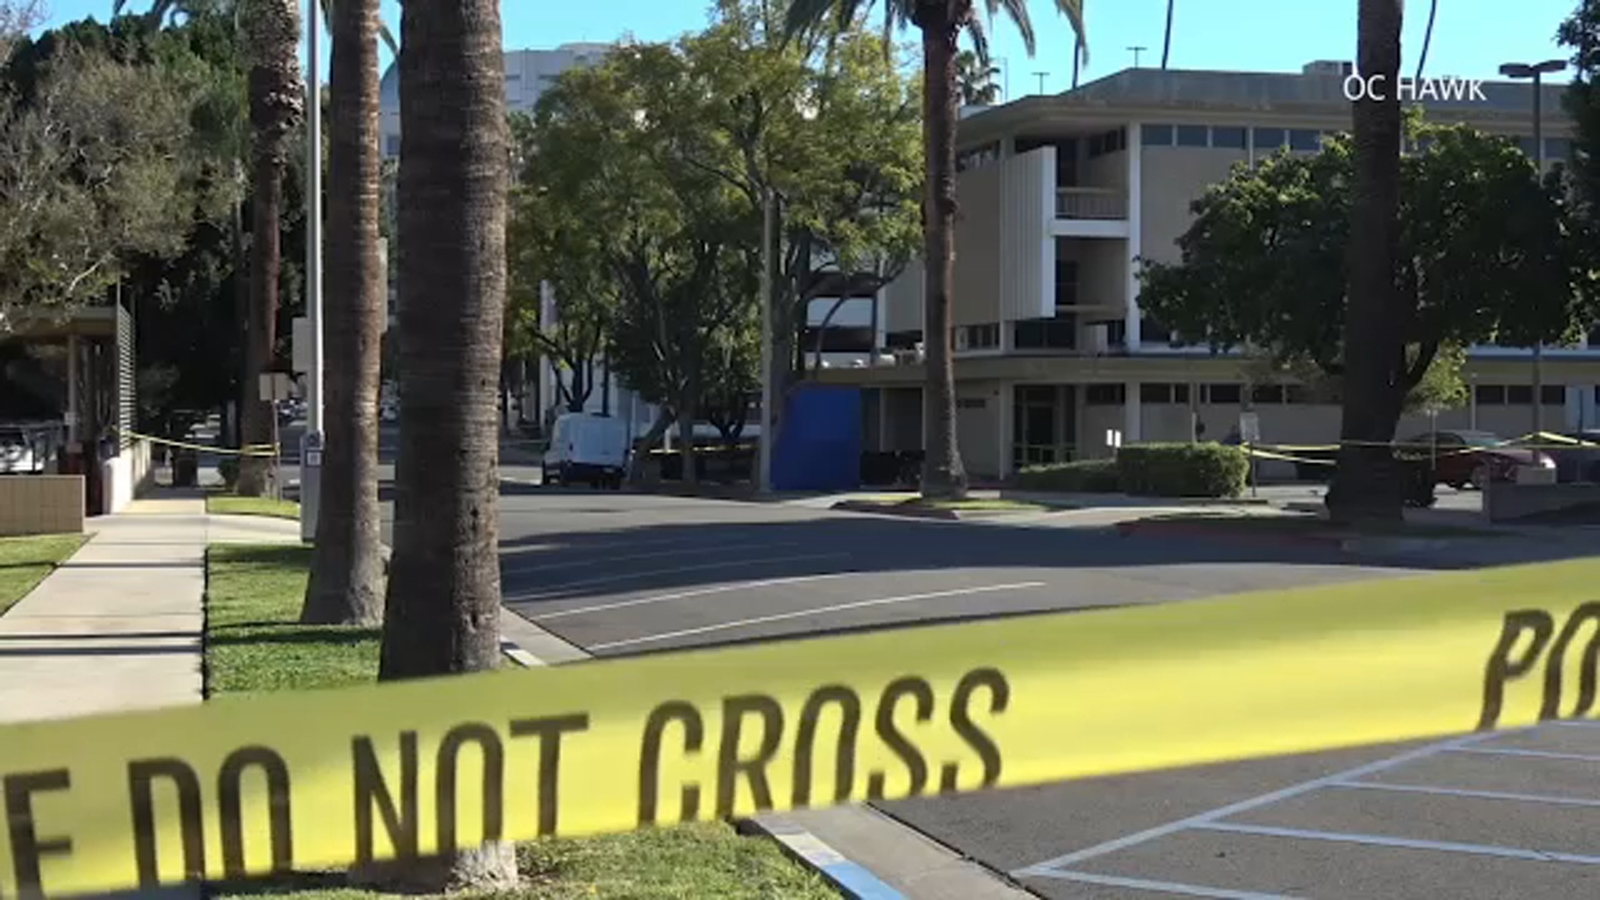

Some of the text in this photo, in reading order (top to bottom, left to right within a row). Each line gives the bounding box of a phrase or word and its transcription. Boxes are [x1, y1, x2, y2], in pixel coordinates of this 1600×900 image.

[128, 745, 293, 889] DO
[351, 712, 590, 865] NOT
[637, 666, 1010, 827] CROSS
